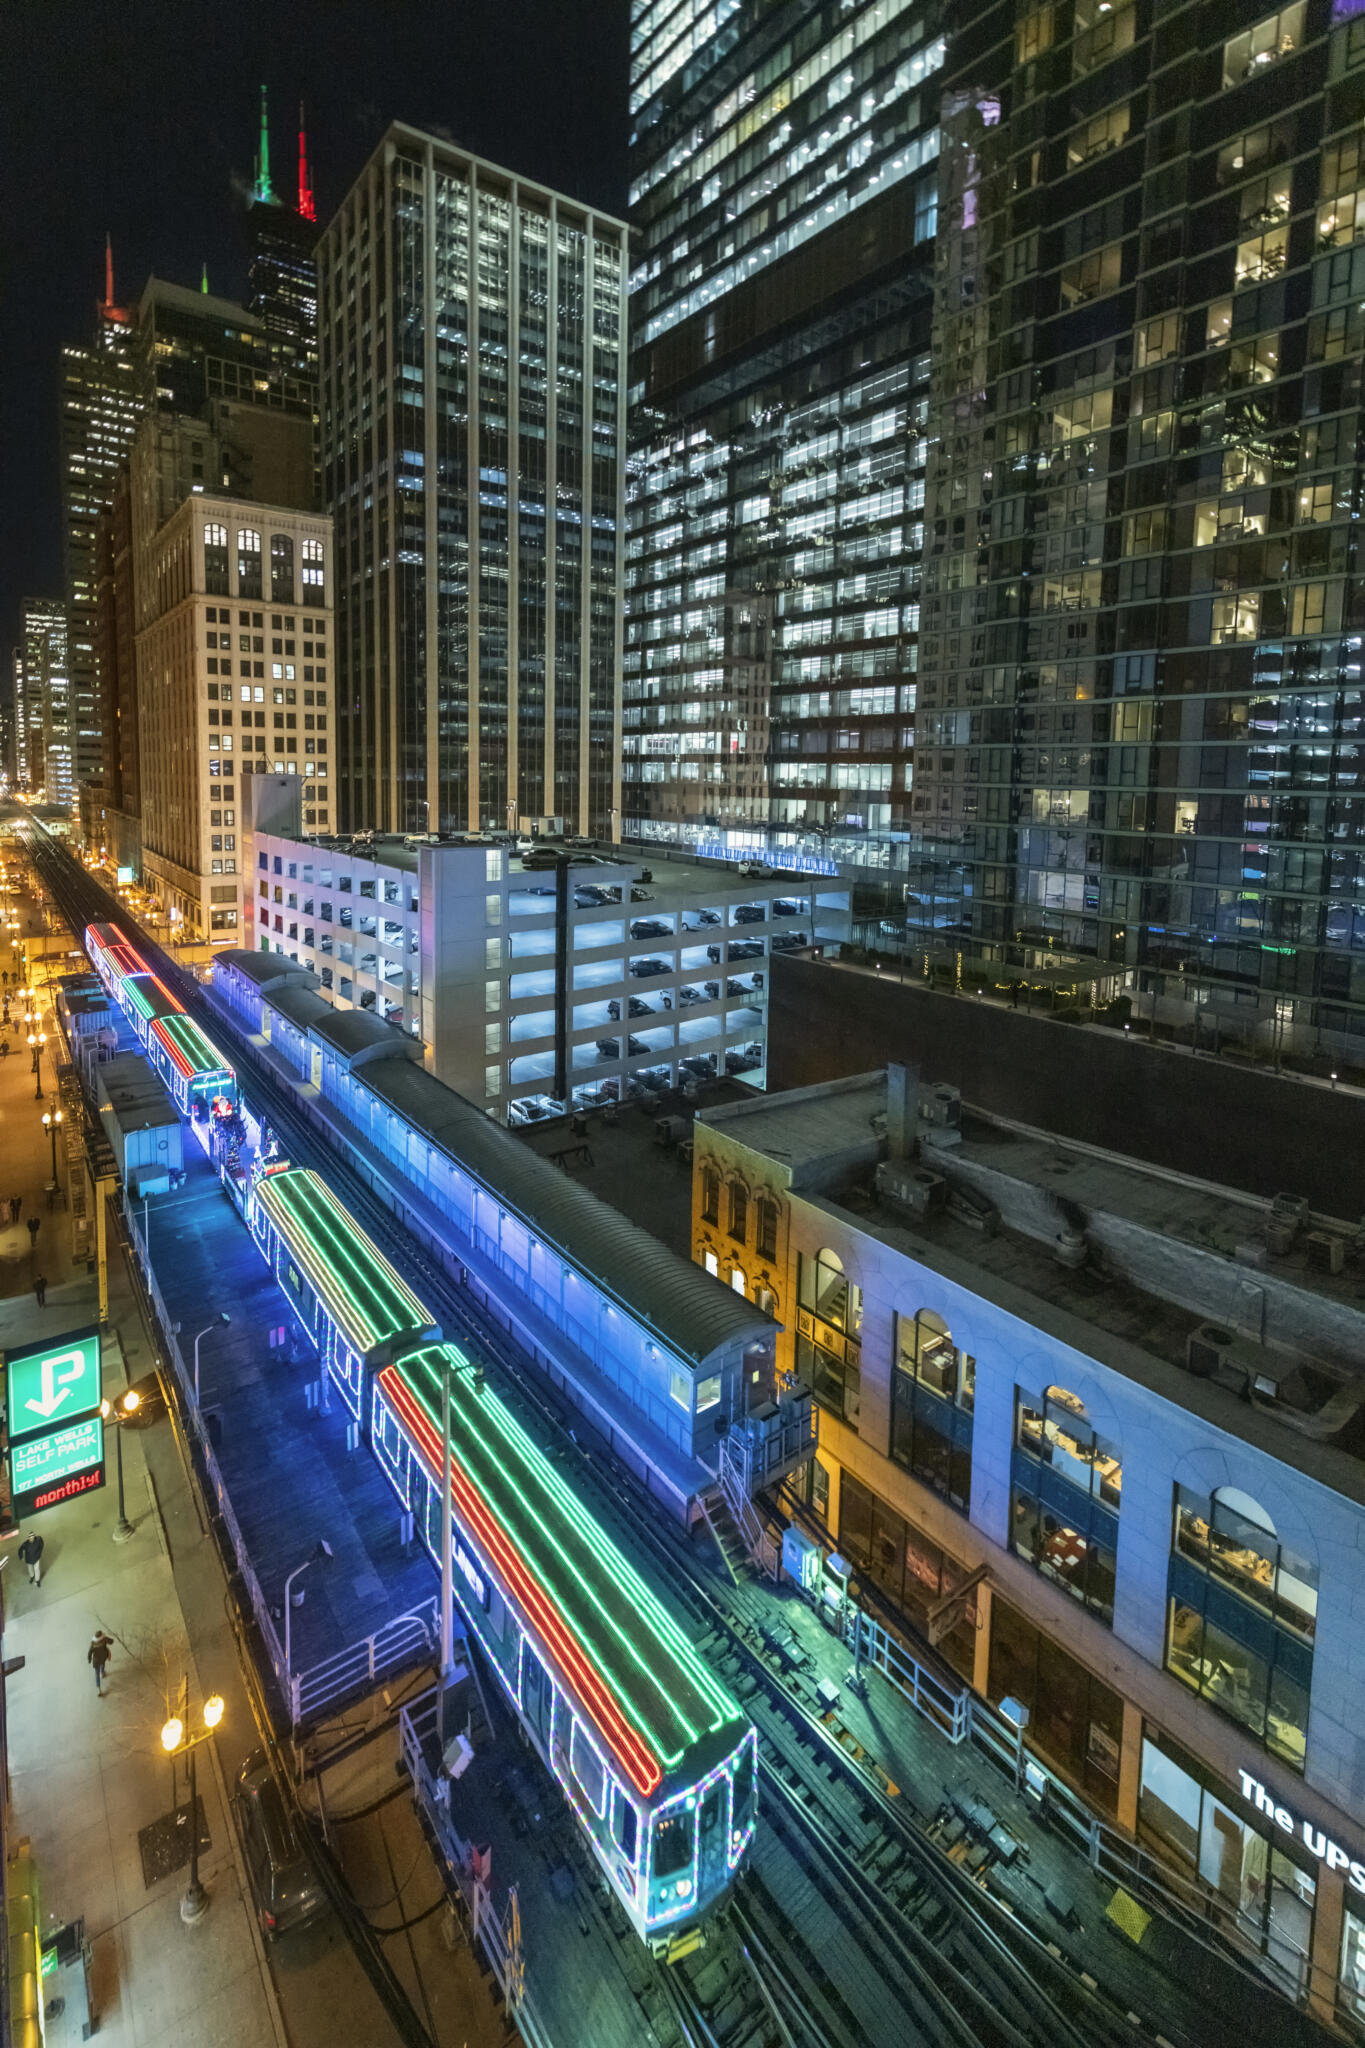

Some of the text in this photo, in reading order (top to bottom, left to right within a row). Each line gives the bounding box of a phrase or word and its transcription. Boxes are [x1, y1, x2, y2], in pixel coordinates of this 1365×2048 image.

[16, 1433, 97, 1472] SELF PARK
[19, 1425, 93, 1459] LAKE WELLS
[18, 1455, 96, 1490] 177 NORTH WELLS
[1238, 1768, 1365, 1895] The UPS
